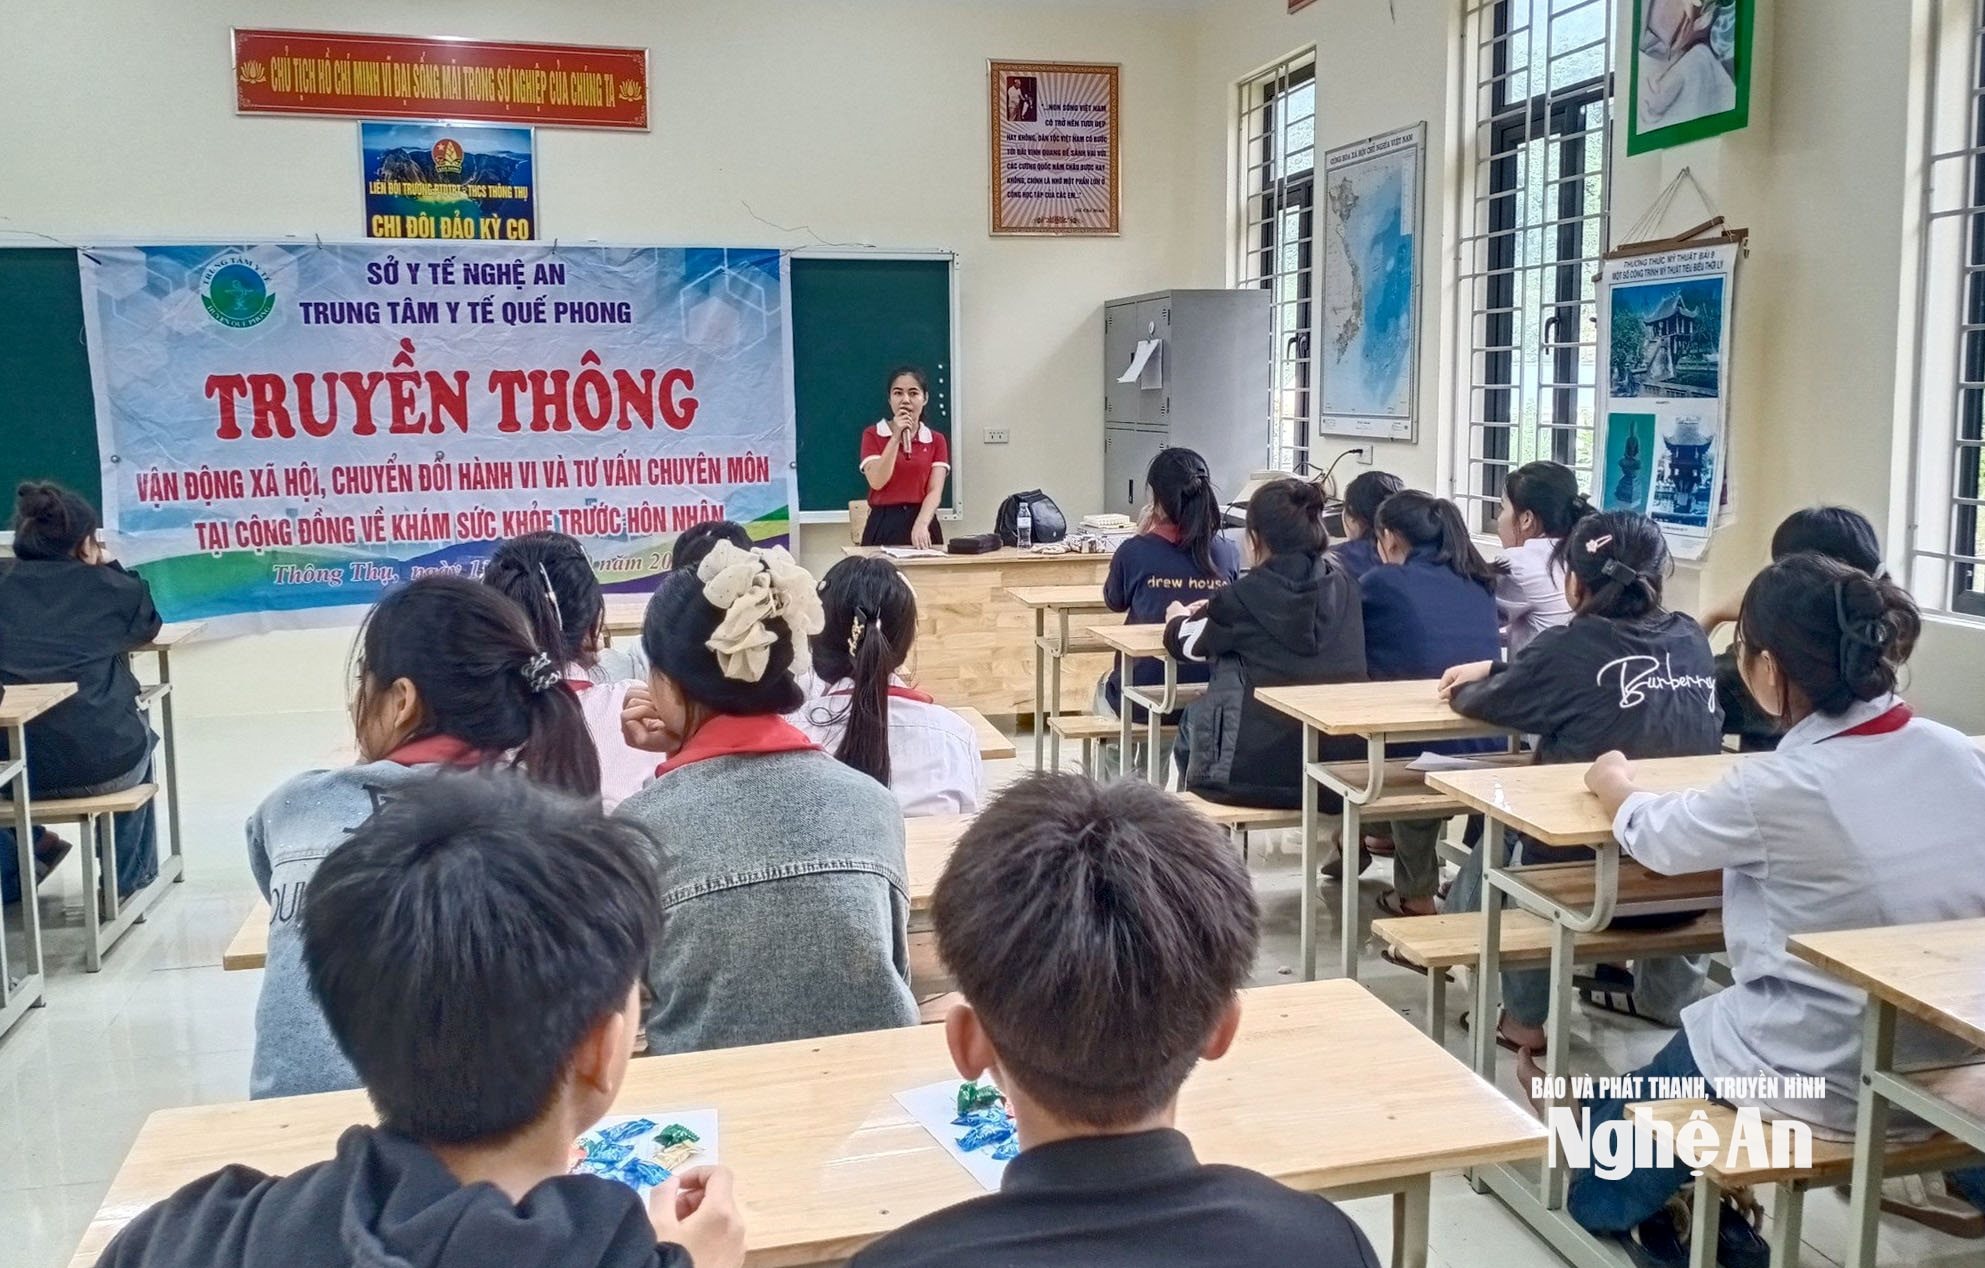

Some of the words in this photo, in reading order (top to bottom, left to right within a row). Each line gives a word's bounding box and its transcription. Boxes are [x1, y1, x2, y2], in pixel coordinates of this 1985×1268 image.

[270, 45, 291, 92] CHỦ
[293, 58, 316, 101] TỊCH
[334, 53, 352, 95] CHÍ
[353, 61, 380, 96] MINH
[381, 55, 392, 97] VĨ
[394, 62, 411, 106] ĐẠI
[412, 51, 440, 100] SỐNG
[442, 59, 461, 100] MÃI
[462, 66, 496, 102] TRONG
[497, 65, 511, 110] SỰ
[513, 62, 548, 112] NGHIỆP
[550, 59, 568, 106] CỦA
[570, 65, 602, 107] CHÚNG
[604, 74, 616, 108] TA
[468, 184, 487, 196] THCS
[488, 183, 512, 198] THÔNG
[514, 186, 528, 202] THỤ
[372, 215, 400, 238] CHI
[440, 210, 474, 240] ĐẢO
[480, 213, 502, 240] KỲ
[506, 218, 529, 240] CO
[367, 255, 400, 286] SỞ
[406, 263, 421, 286] Y
[428, 256, 456, 286] TẾ
[464, 259, 526, 290] NGHỆ
[534, 263, 566, 286] AN
[299, 301, 380, 324] TRUNG
[387, 298, 438, 324] TÂM
[448, 301, 463, 324] Y
[468, 294, 496, 324] TẾ
[502, 294, 548, 326] QUẾ
[554, 302, 632, 324] PHONG
[204, 336, 471, 440] TRUYỀN
[488, 348, 700, 433] THÔNG
[136, 467, 179, 508] VẬN
[184, 464, 244, 506] ĐỘNG
[250, 463, 280, 498] XÃ
[284, 461, 326, 502] HỘI,
[332, 453, 412, 495] CHUYỂN
[418, 451, 452, 492] ĐỔI
[458, 456, 513, 490] HÀNH
[518, 460, 538, 489] VI
[542, 454, 569, 488] VÀ
[574, 456, 600, 488] TƯ
[602, 449, 642, 487] VẤN
[647, 451, 722, 486] CHUYÊN
[727, 452, 770, 483] MÔN
[195, 521, 230, 556] TẠI
[235, 514, 292, 552] CỘNG
[297, 507, 356, 546] ĐỒNG
[360, 506, 386, 543] VỀ
[392, 507, 451, 542] KHÁM
[456, 506, 496, 540] SỨC
[502, 500, 553, 537] KHỎE
[559, 504, 625, 536] TRƯỚC
[626, 501, 667, 534] HÔN
[672, 499, 724, 532] NHÂN
[273, 564, 343, 586] Thông
[350, 561, 399, 587] Thụ,
[600, 554, 642, 572] năm
[1148, 576, 1182, 588] drew
